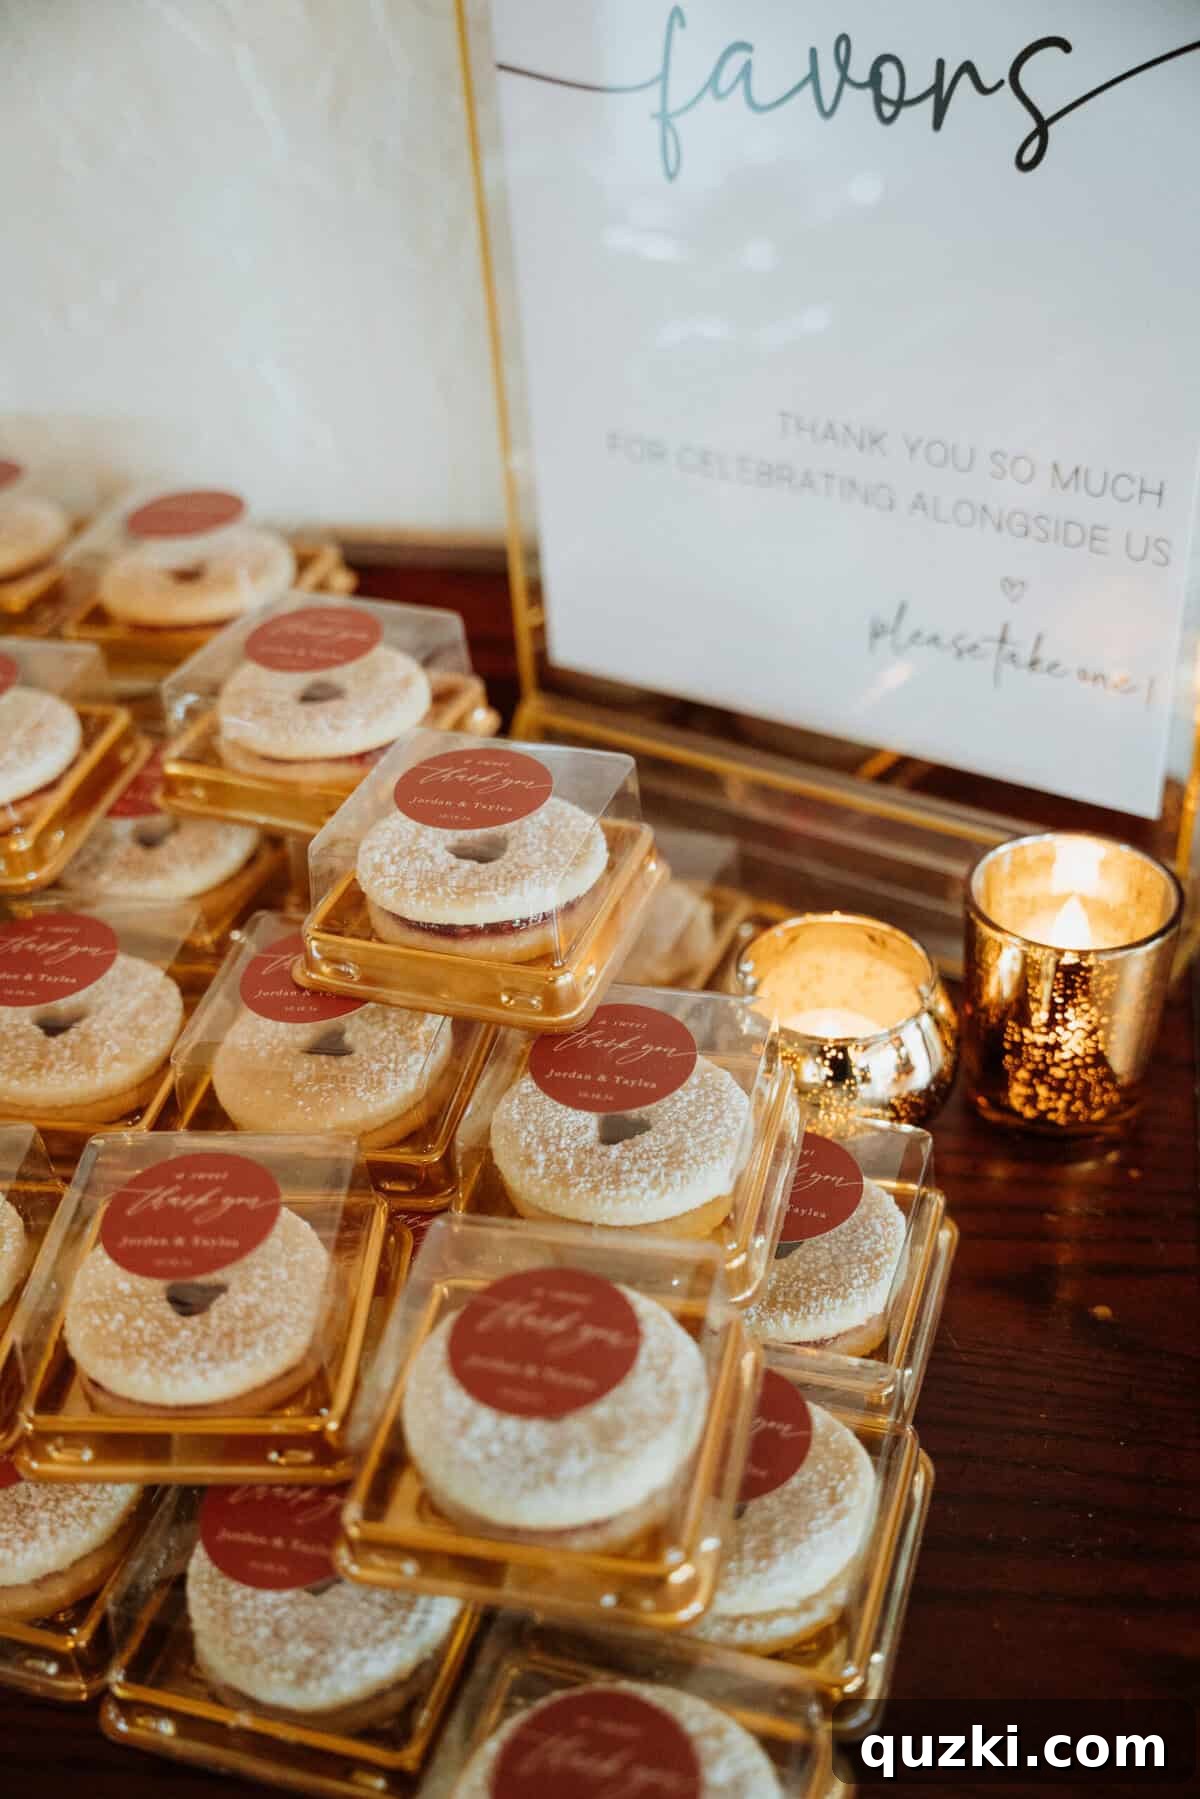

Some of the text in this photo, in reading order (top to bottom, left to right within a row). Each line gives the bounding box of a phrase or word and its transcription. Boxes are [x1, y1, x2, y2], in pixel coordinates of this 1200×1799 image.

[497, 4, 1200, 182] favors
[605, 430, 1172, 567] FOR CELEBRATING ALONGSIDE US
[778, 408, 1165, 508] THANK YOU SO MUCH
[867, 599, 983, 660] please
[980, 620, 1068, 689] take
[545, 1068, 592, 1081] Jordan
[597, 1073, 608, 1083] &
